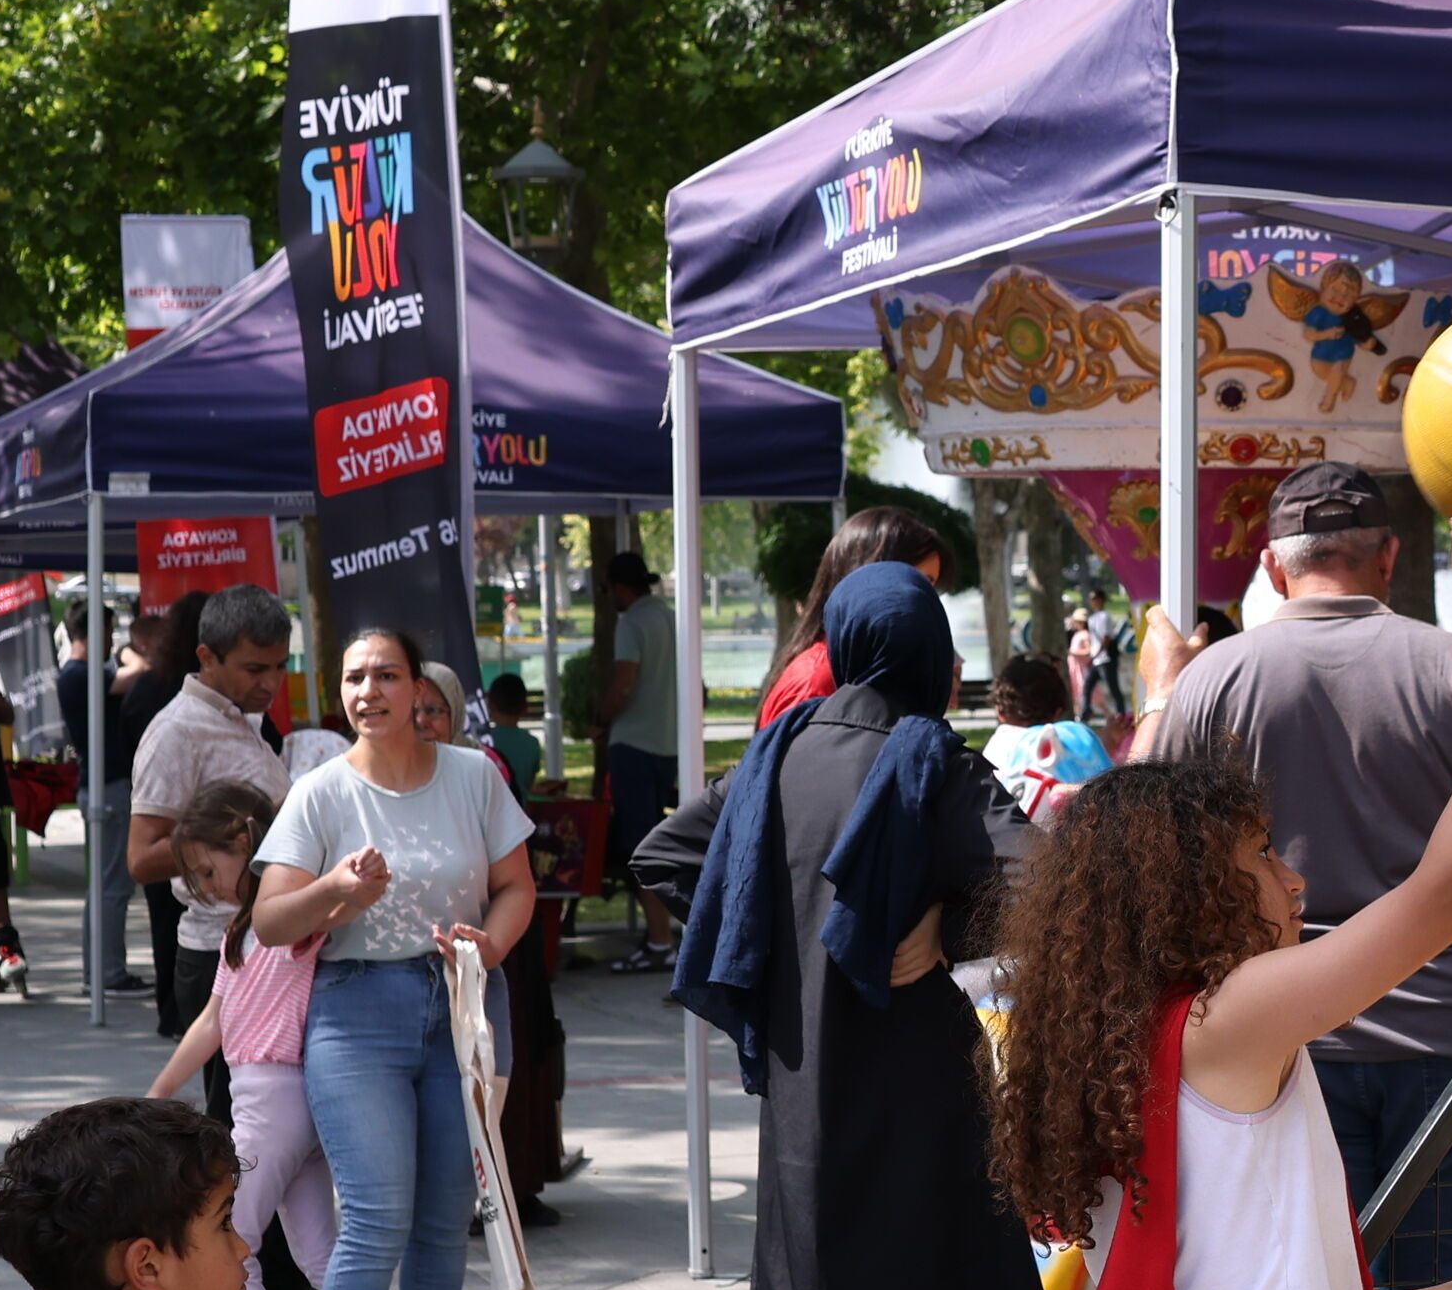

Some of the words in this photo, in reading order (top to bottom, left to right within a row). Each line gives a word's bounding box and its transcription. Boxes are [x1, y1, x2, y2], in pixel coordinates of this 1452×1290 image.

[816, 165, 878, 250] KÜLTÜR
[877, 148, 923, 224] YOLU
[841, 226, 898, 276] FESTİVALİ
[484, 434, 547, 467] YOLU
